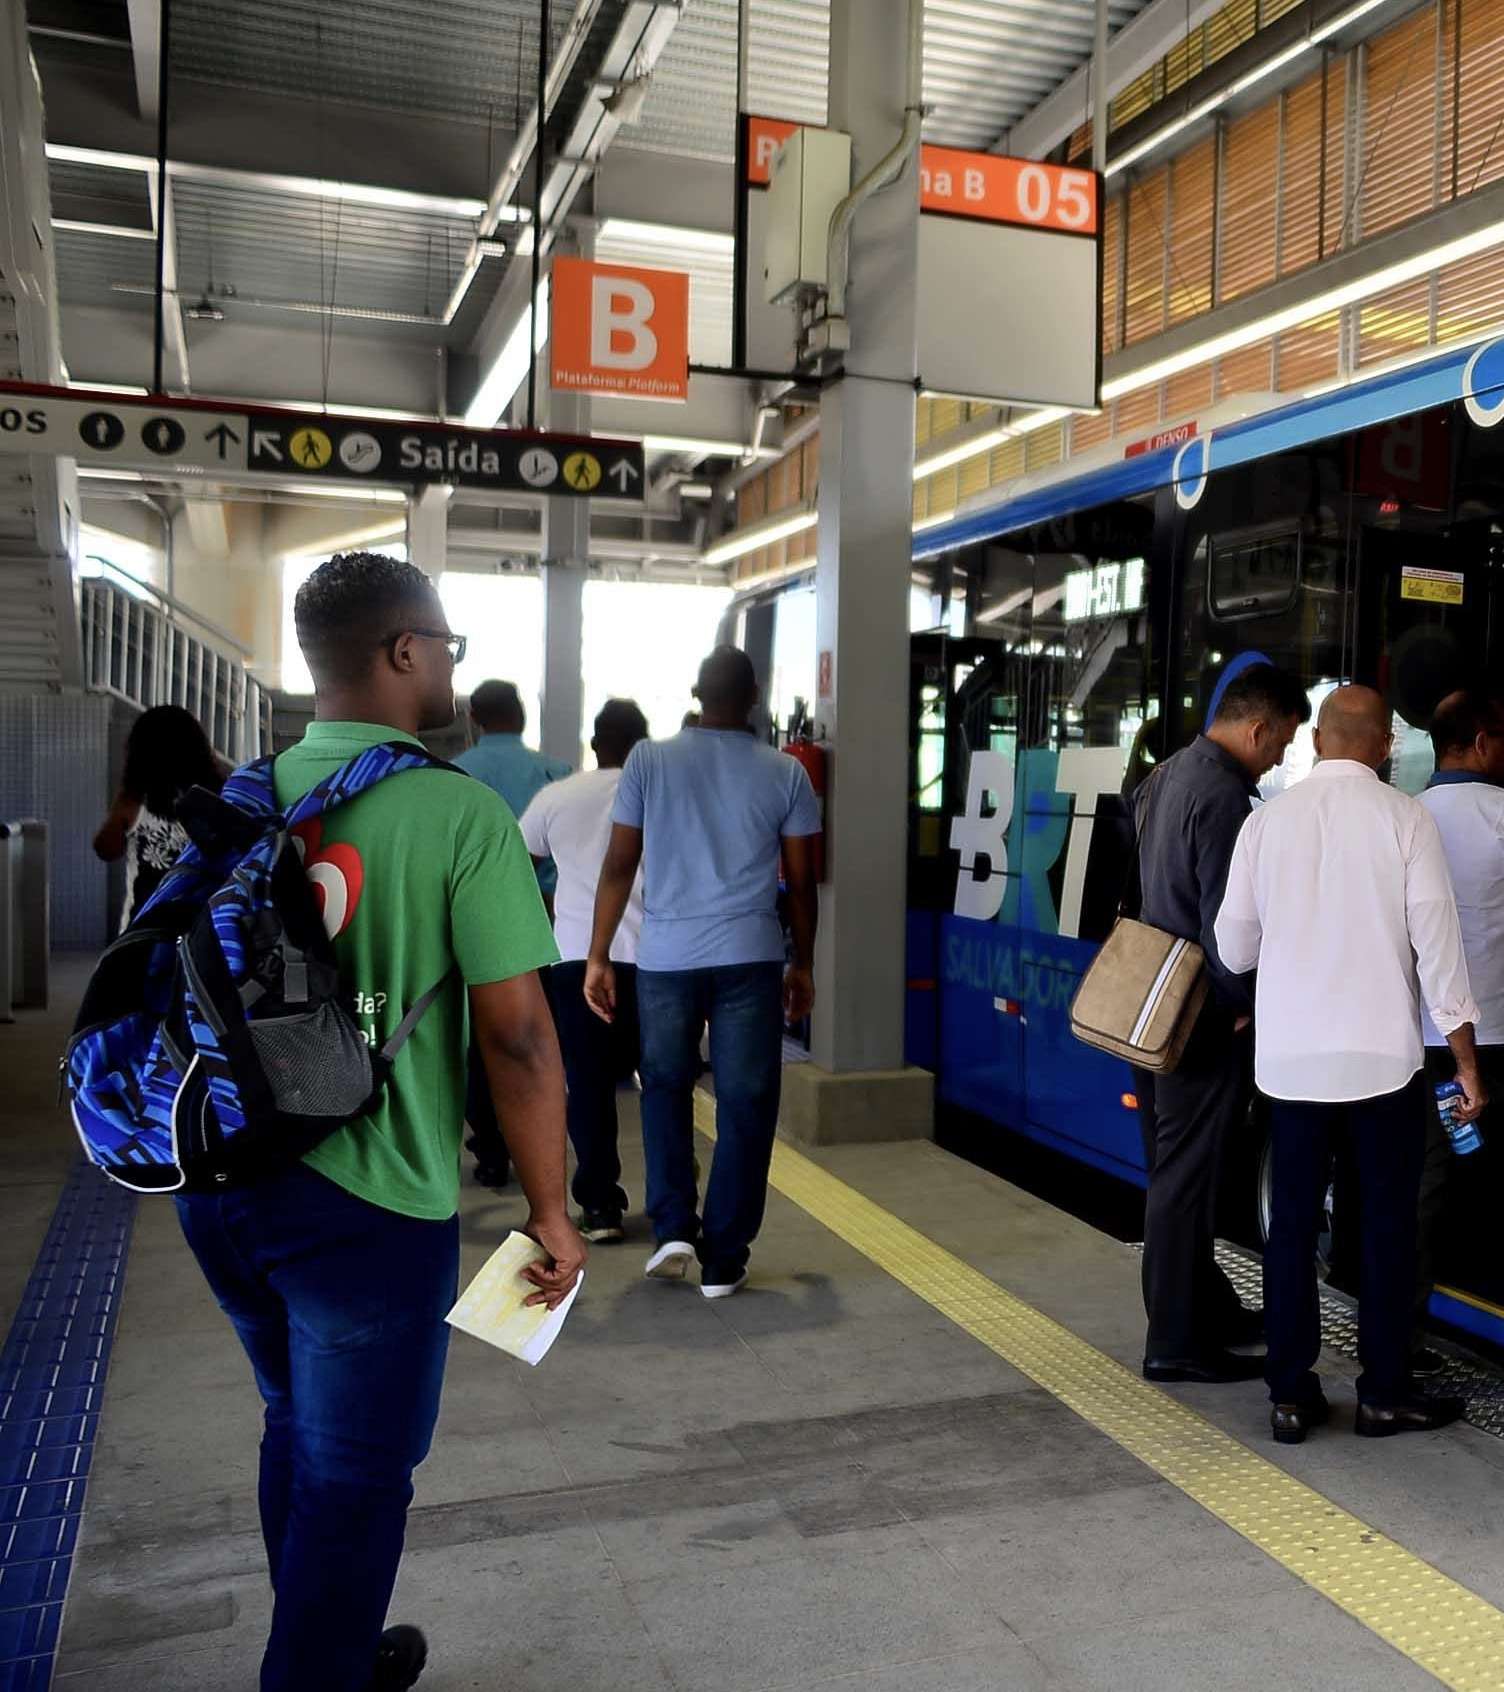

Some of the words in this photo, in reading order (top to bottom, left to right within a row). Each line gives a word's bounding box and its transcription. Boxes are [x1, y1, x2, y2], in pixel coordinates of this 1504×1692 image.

[964, 168, 986, 201] B
[1016, 163, 1091, 228] 05
[591, 275, 658, 372] B
[556, 370, 626, 389] Plataforma
[627, 377, 680, 394] Platform
[400, 436, 500, 475] Saída
[950, 746, 1127, 939] BRT
